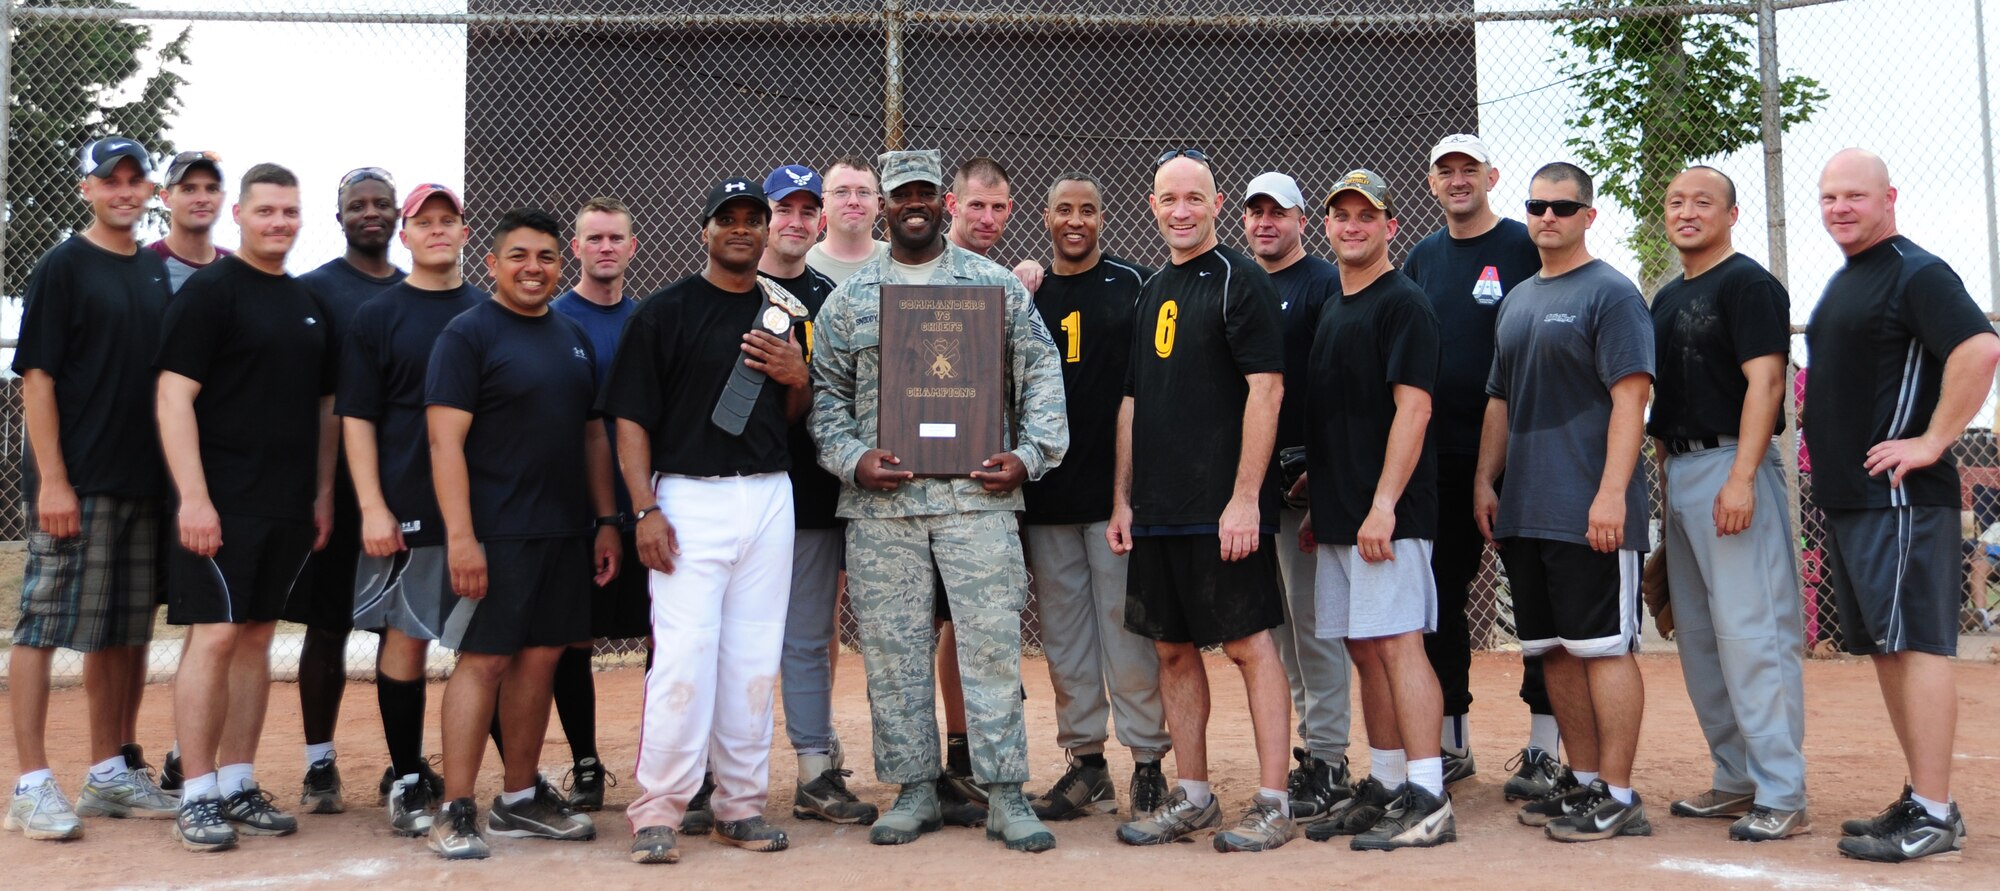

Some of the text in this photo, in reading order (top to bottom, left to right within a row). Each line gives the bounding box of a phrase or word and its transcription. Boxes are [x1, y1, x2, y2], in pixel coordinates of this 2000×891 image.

[899, 299, 985, 310] COMMANDERS
[934, 311, 950, 320] VS
[921, 322, 963, 332] CHIEFS
[1154, 299, 1178, 359] 6
[1060, 310, 1081, 363] 1
[906, 387, 976, 398] CHAMPIONS
